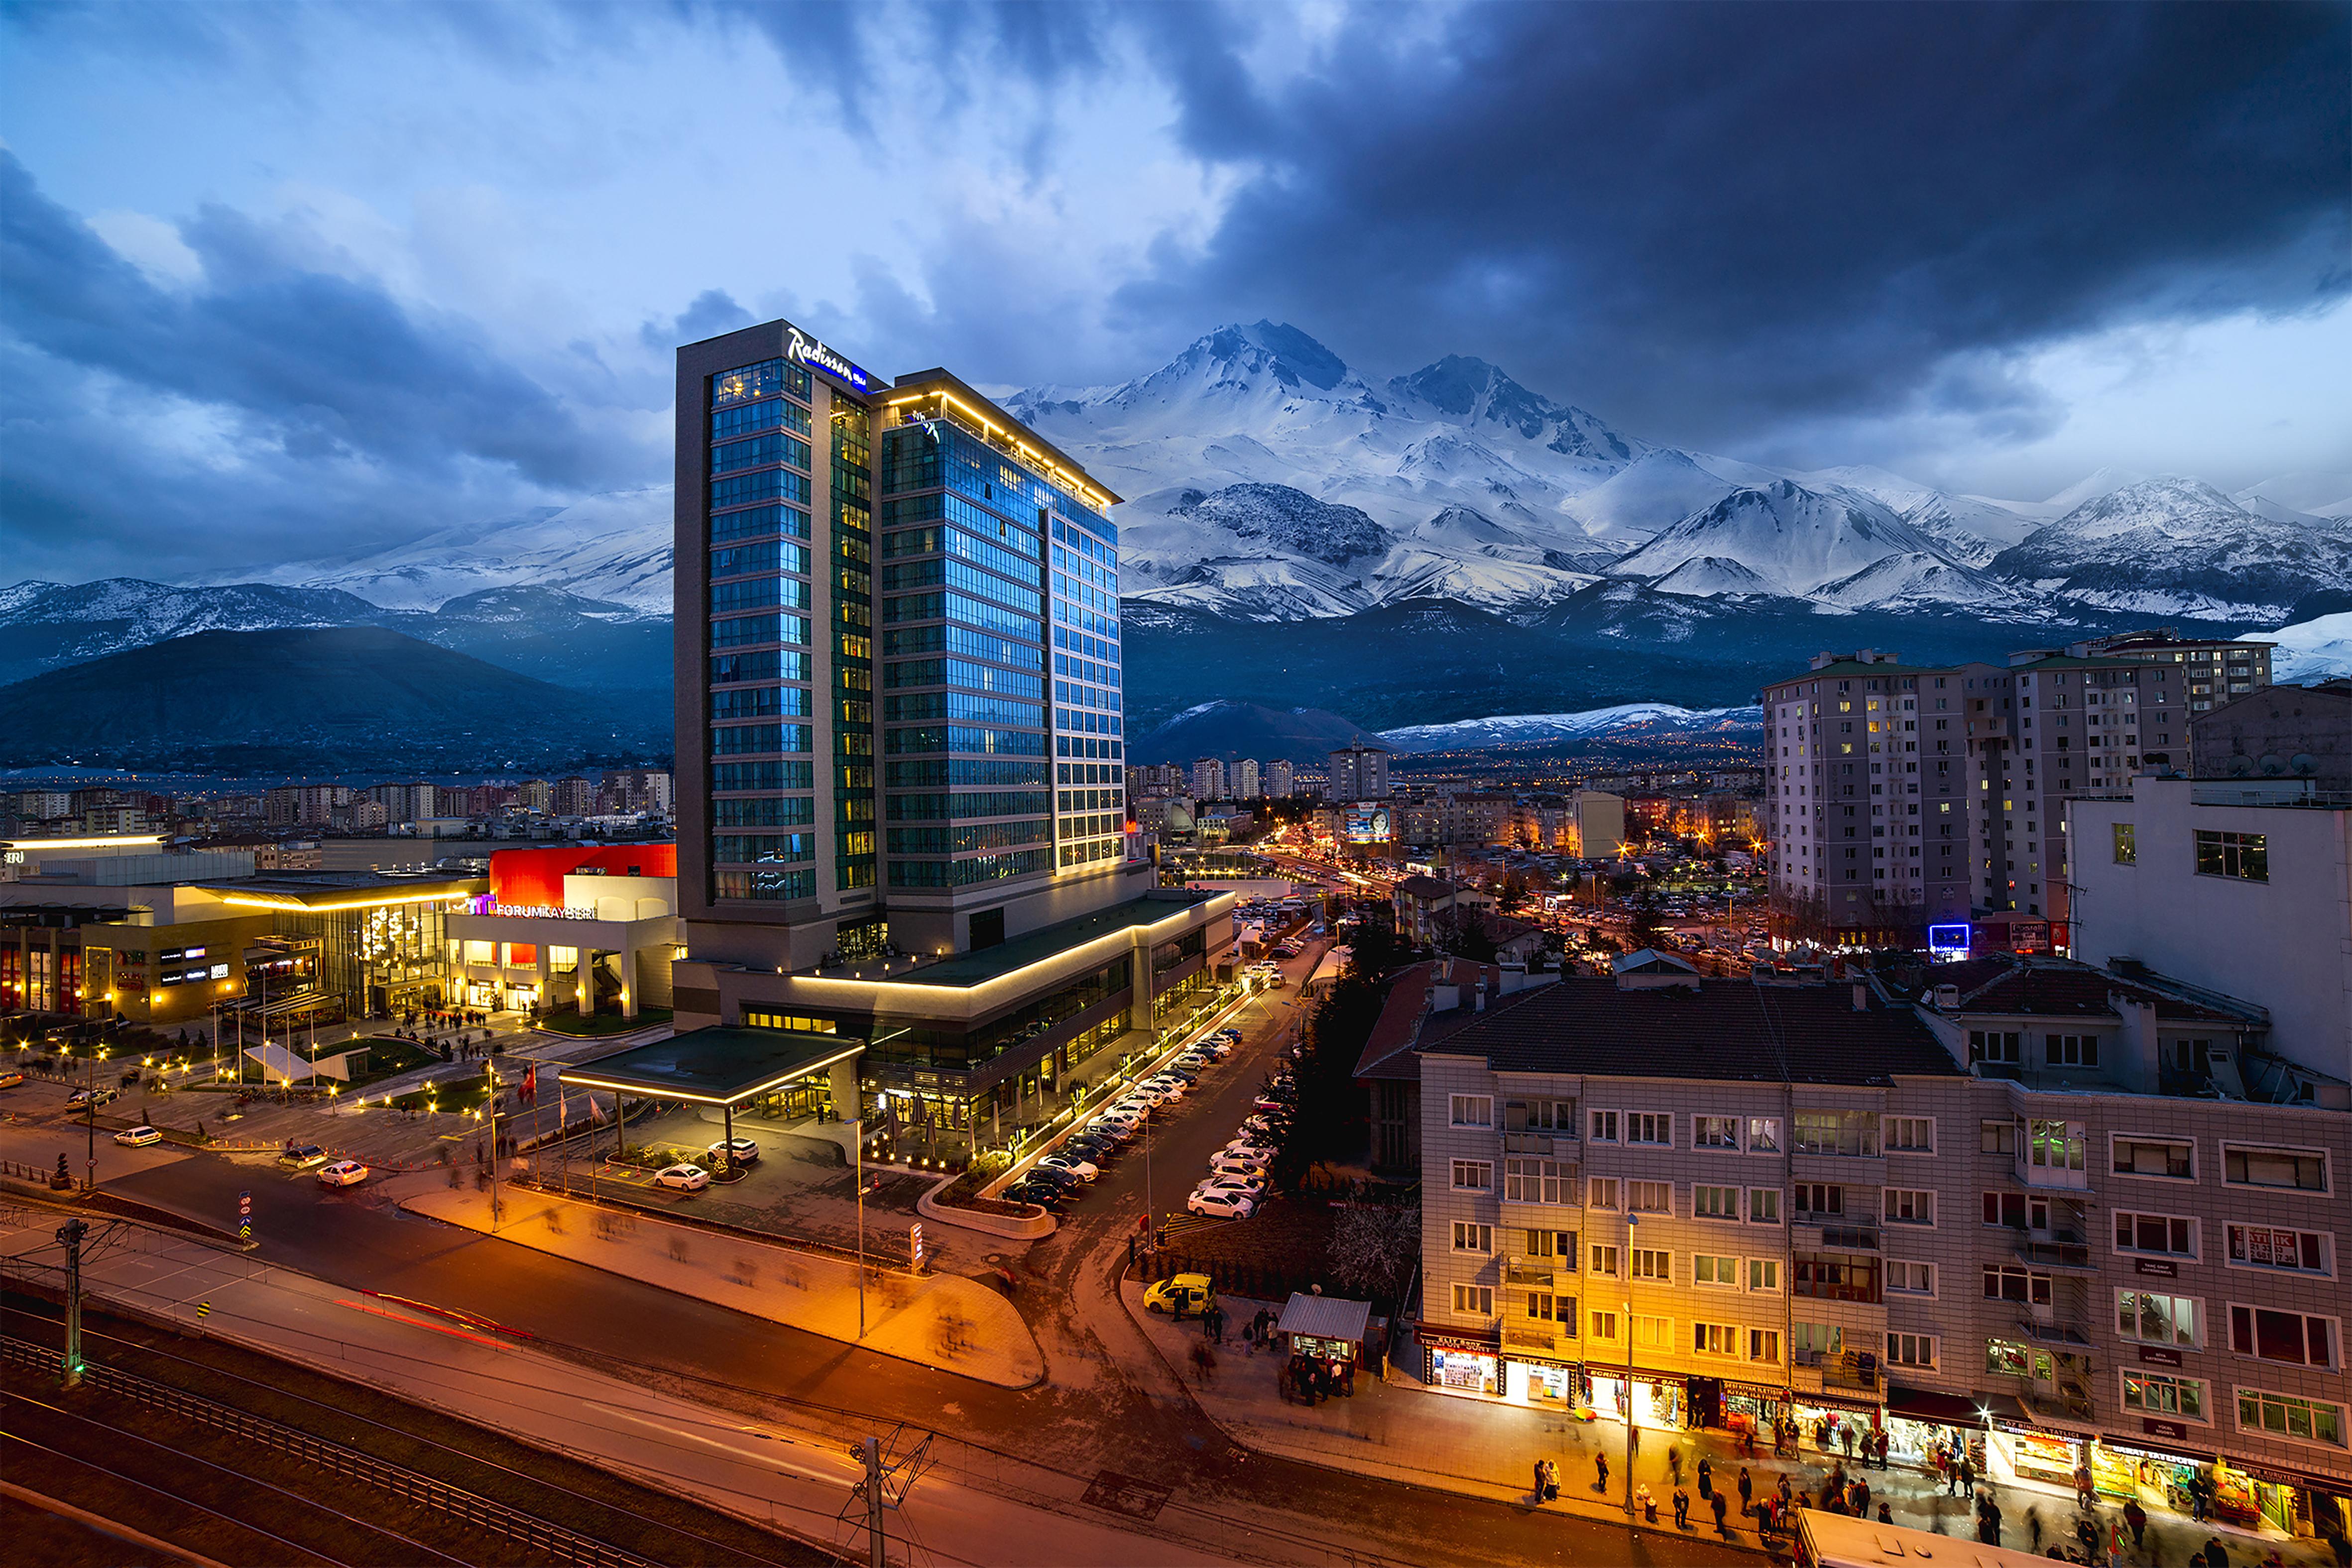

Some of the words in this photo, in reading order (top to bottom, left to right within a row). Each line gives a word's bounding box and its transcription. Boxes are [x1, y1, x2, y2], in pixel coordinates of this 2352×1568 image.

[788, 327, 852, 381] Radisson
[1590, 1370, 1620, 1378] ECRİN
[2113, 1445, 2144, 1457] SARAY
[2231, 1463, 2261, 1475] YILDIRIM
